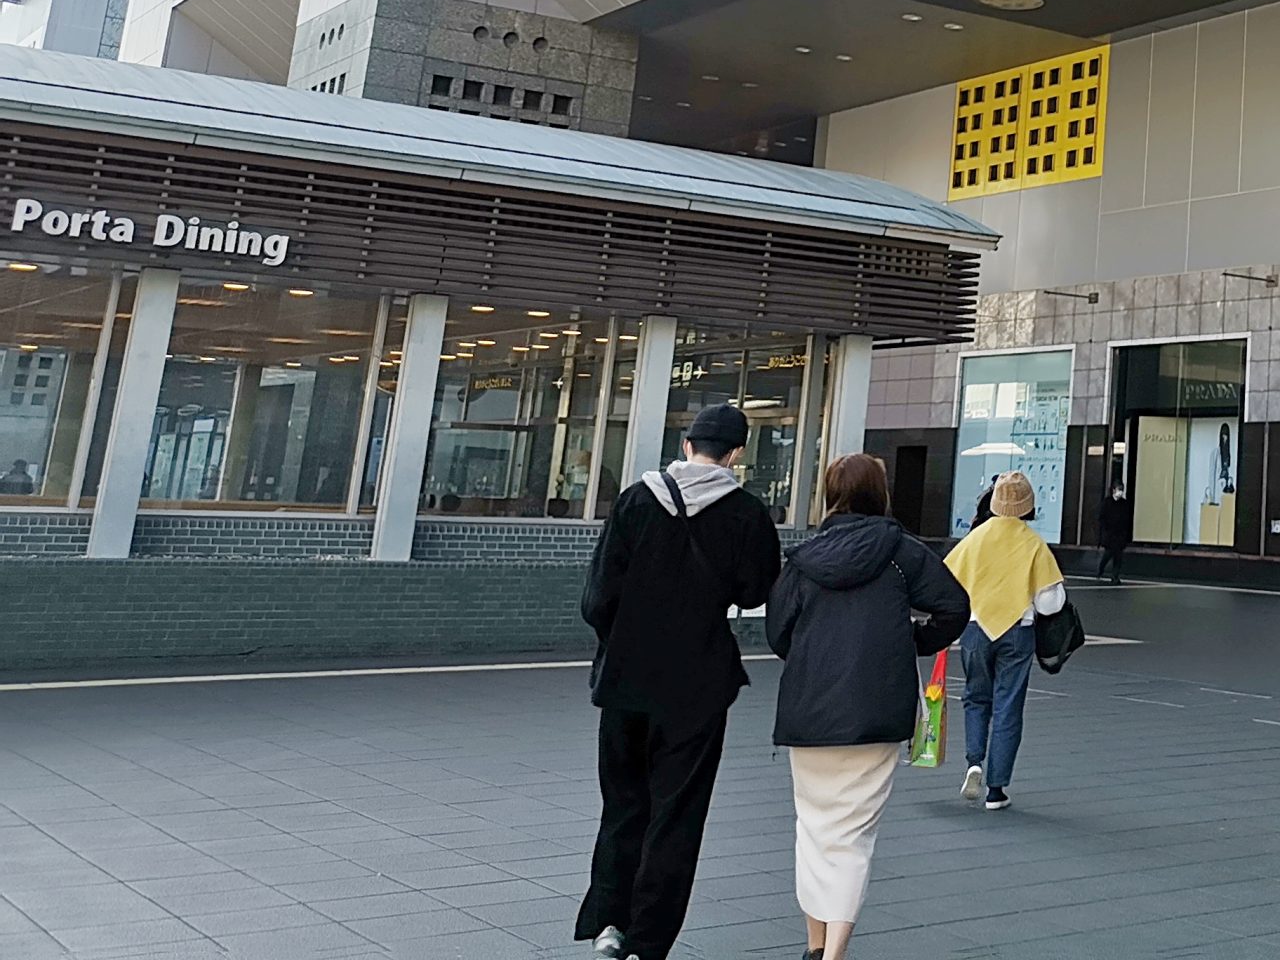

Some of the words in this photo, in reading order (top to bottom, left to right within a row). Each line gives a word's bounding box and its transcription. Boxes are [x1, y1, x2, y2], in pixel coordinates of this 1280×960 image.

[10, 197, 135, 245] Porta
[152, 213, 291, 267] Dining
[1185, 382, 1238, 400] PRADA
[1143, 433, 1184, 443] PRADA
